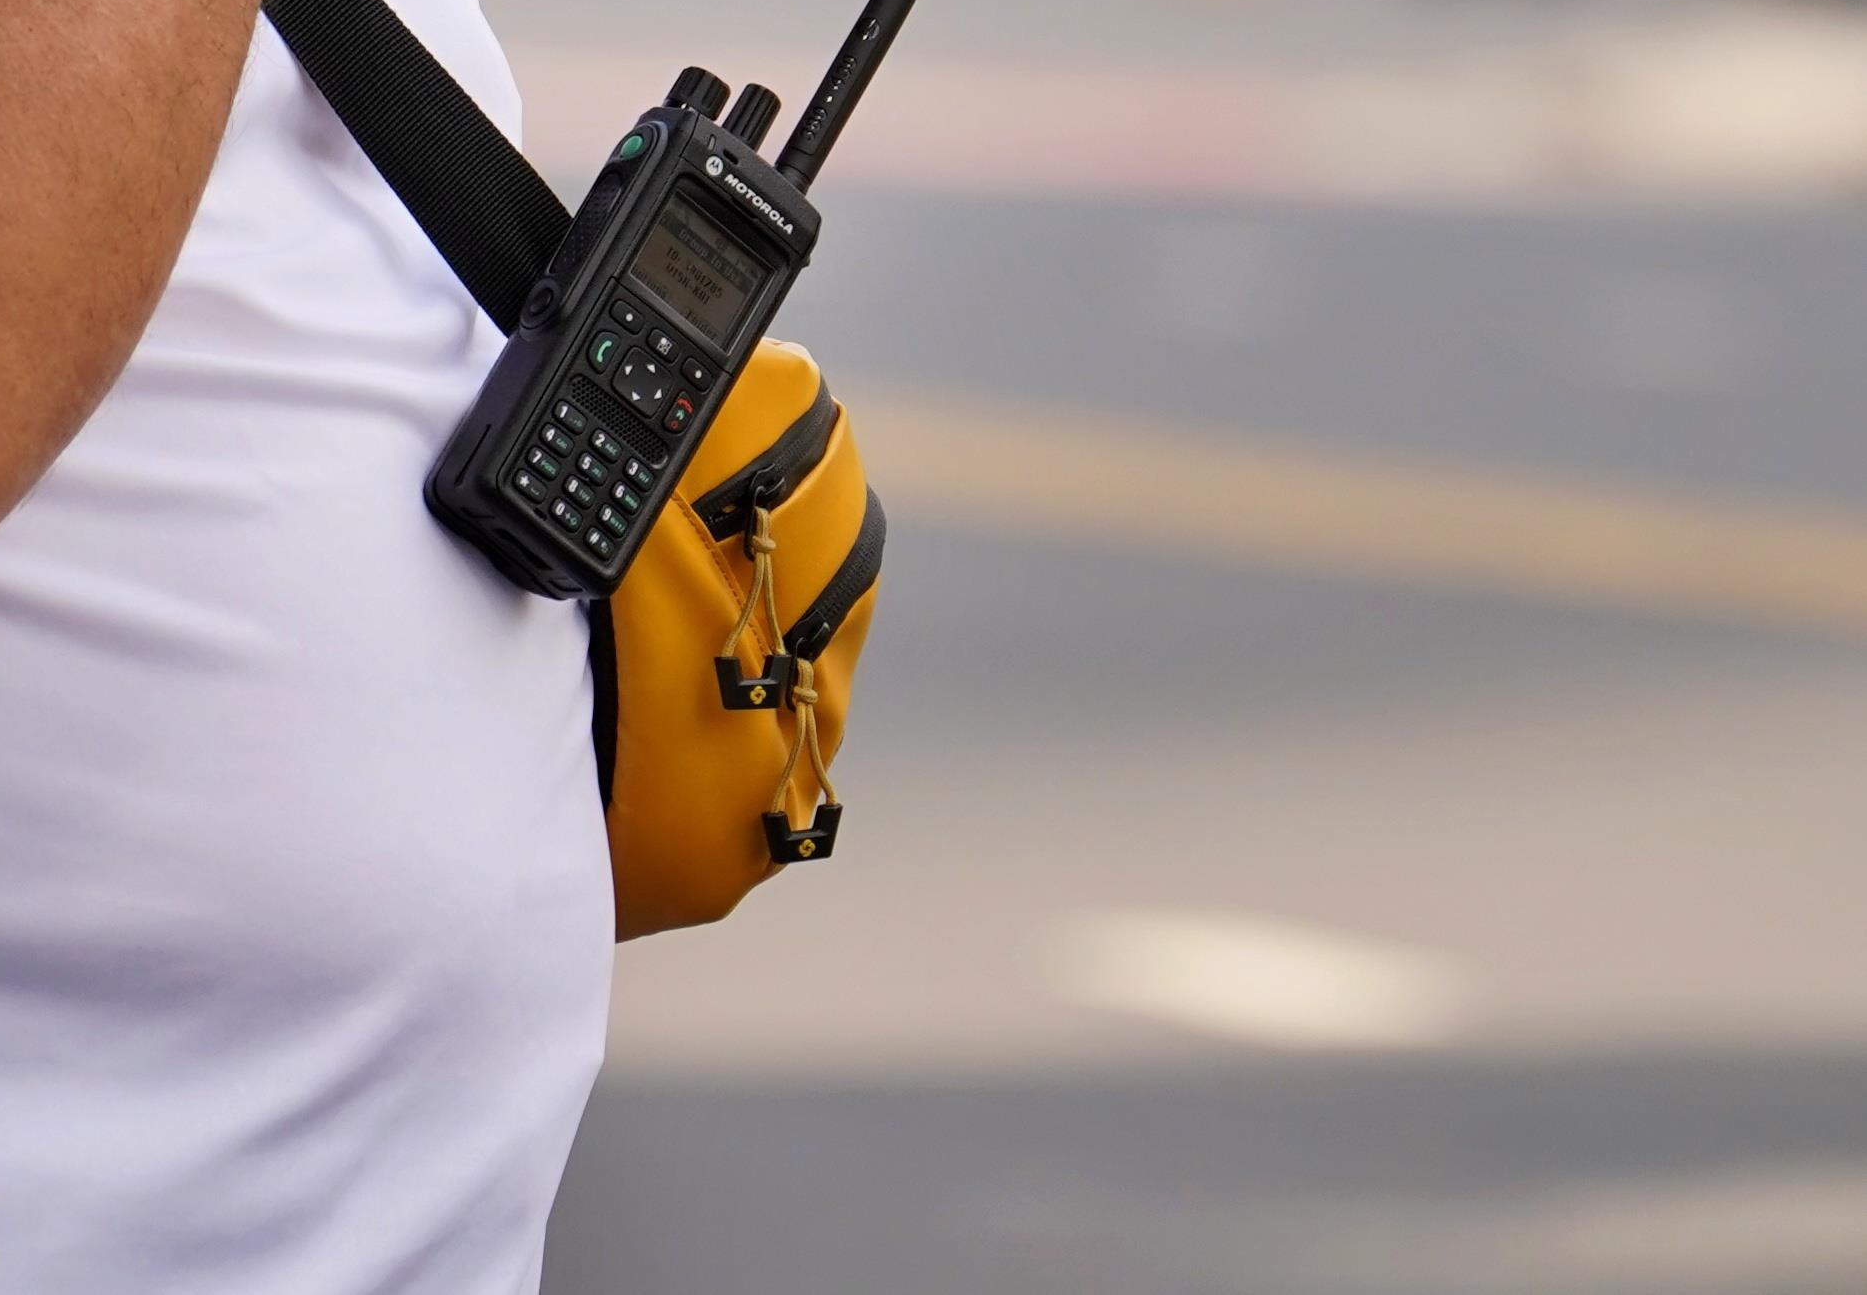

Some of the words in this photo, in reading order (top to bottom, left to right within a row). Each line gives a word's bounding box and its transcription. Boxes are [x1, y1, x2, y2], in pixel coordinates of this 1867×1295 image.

[724, 173, 794, 235] MOTOROLA
[559, 405, 569, 418] 1
[546, 429, 555, 442] 4
[595, 433, 606, 447] 2
[532, 450, 542, 464] 7
[582, 456, 592, 470] 5
[628, 462, 639, 476] 3
[568, 479, 579, 493] 8
[615, 485, 625, 498] 6
[555, 502, 565, 516] 0
[602, 507, 612, 521] 9
